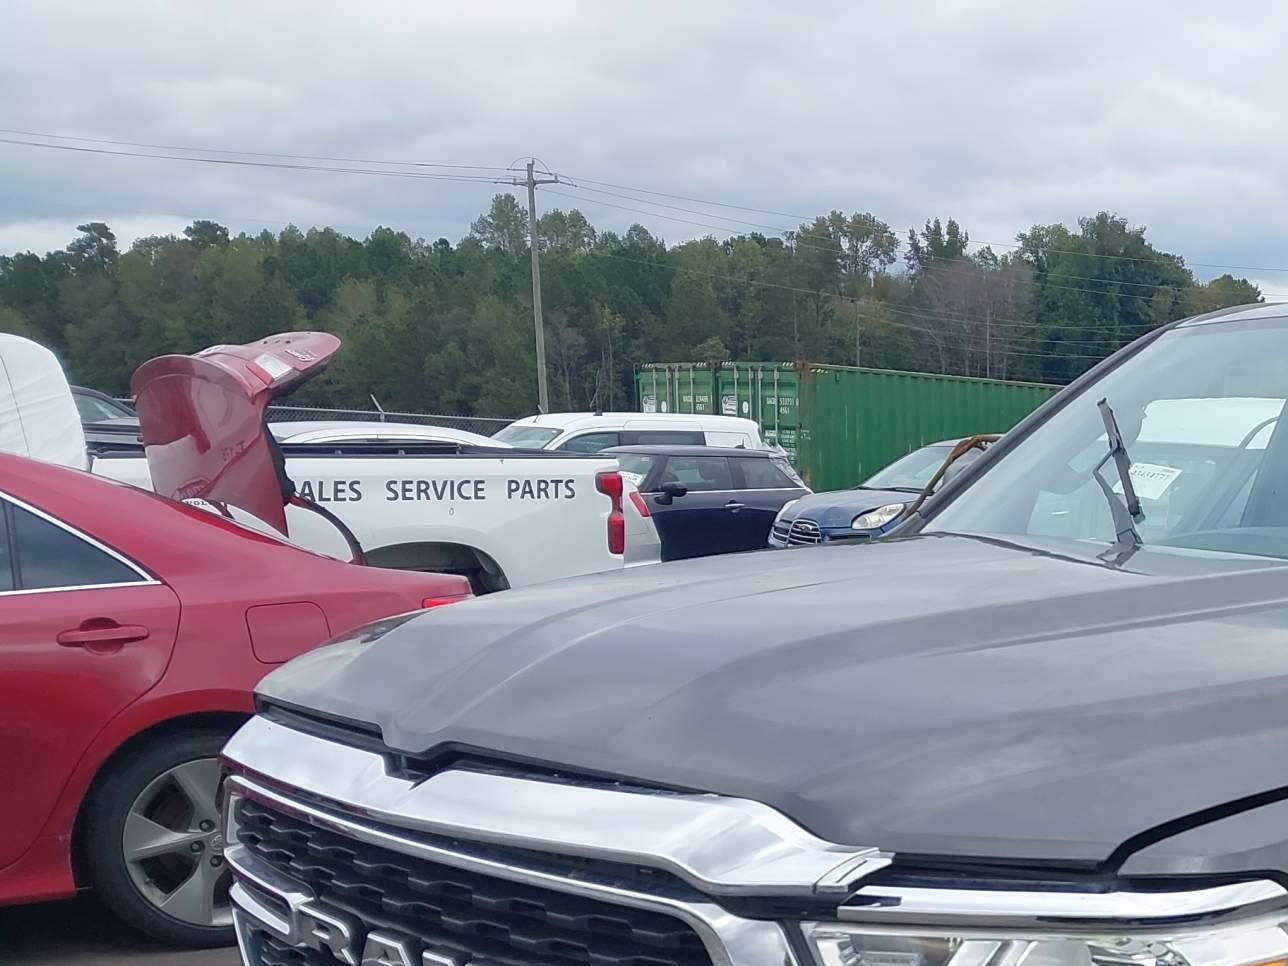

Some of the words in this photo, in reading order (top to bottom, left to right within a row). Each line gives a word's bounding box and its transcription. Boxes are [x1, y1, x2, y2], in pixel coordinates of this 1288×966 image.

[299, 480, 362, 502] ALES
[385, 479, 486, 501] SERVICE
[506, 478, 576, 500] PARTS
